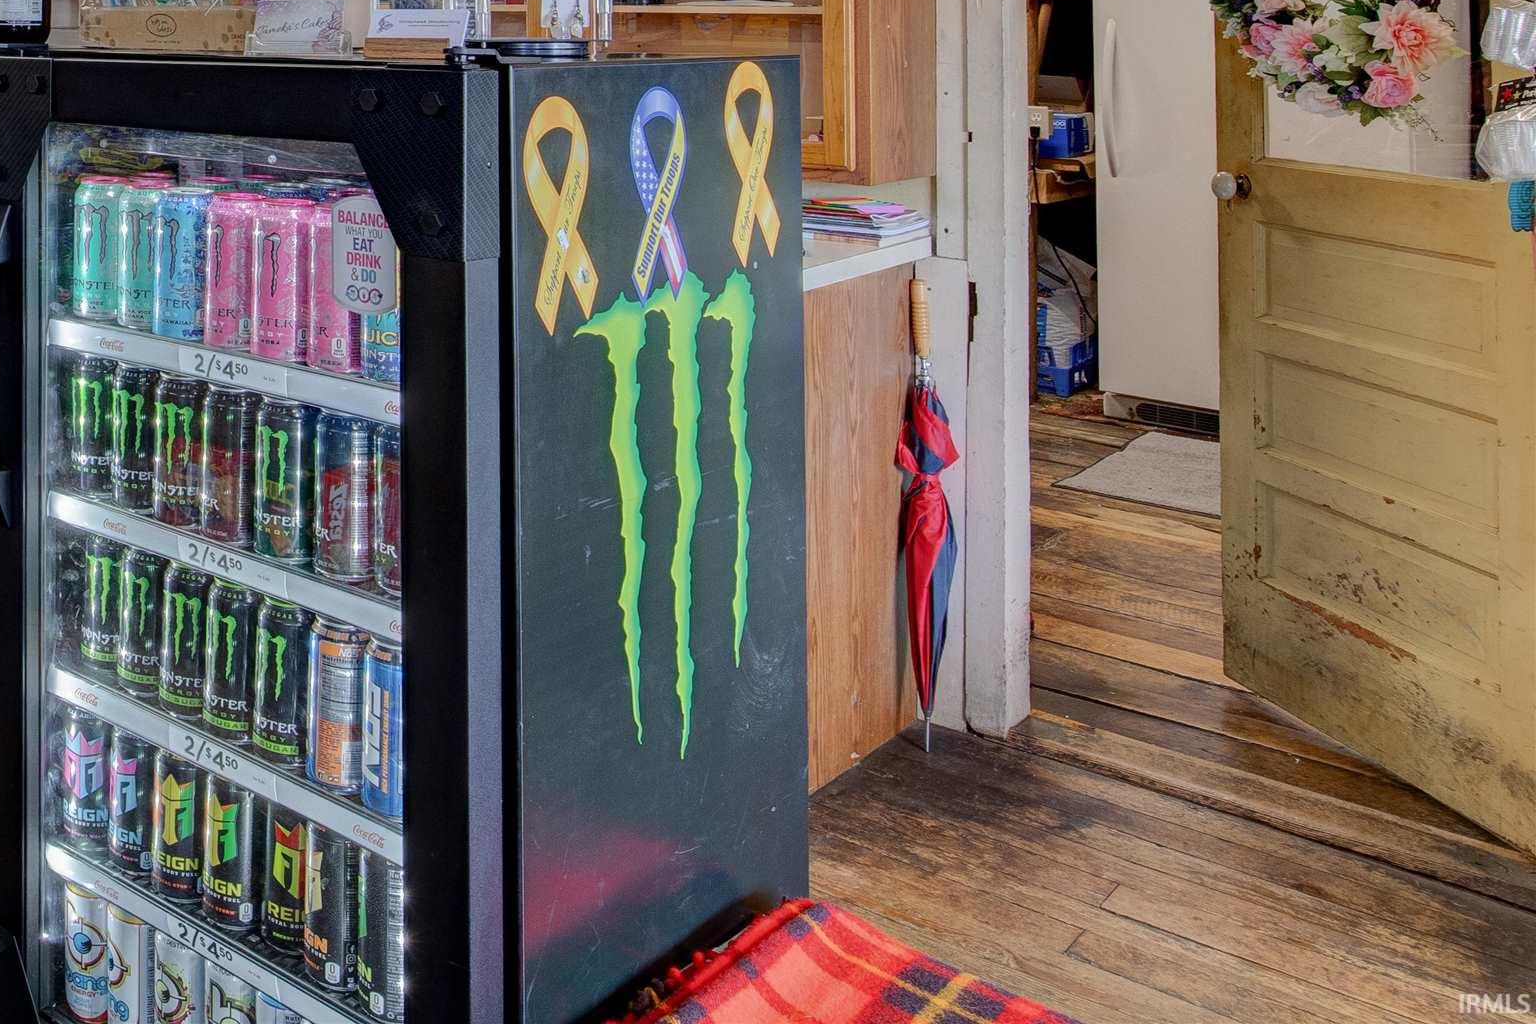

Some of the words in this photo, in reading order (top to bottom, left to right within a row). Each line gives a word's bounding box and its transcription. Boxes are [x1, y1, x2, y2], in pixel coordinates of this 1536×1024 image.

[637, 224, 660, 277] Support
[654, 202, 667, 223] Our
[661, 153, 681, 203] Troops
[345, 225, 367, 237] WHAT
[367, 228, 383, 239] YOU
[352, 237, 373, 251] EAT
[346, 254, 381, 270] DRINK
[351, 268, 359, 281] &
[361, 269, 376, 284] DO
[64, 799, 109, 822] REIGN
[267, 899, 305, 923] REI
